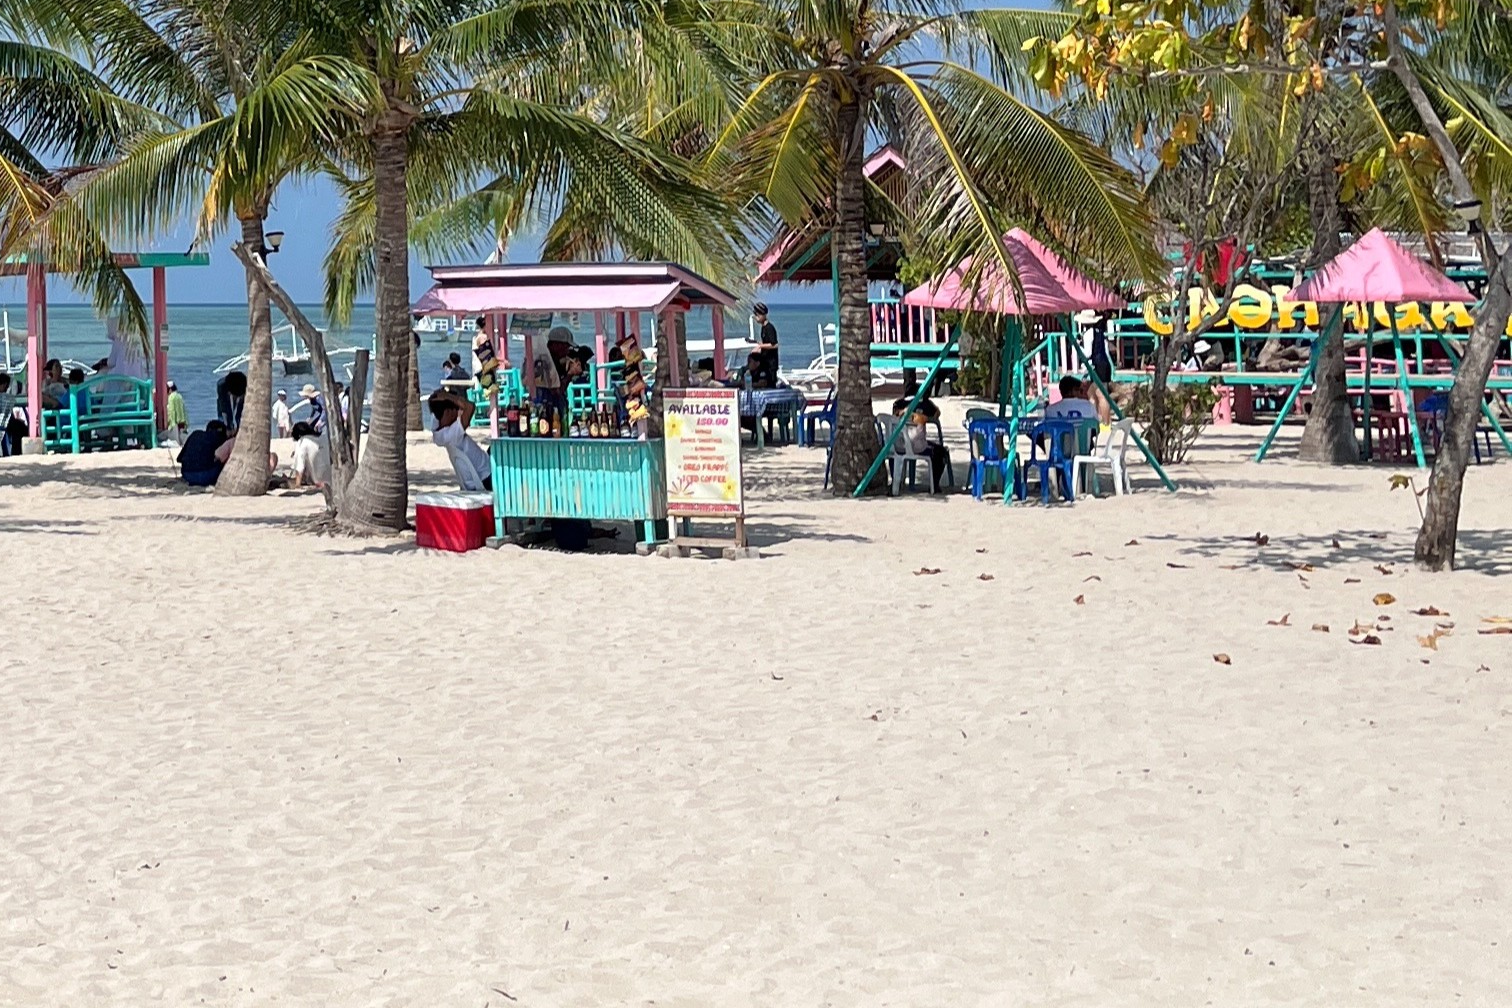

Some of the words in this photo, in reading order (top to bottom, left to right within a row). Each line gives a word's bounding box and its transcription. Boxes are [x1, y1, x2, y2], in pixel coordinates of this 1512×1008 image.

[668, 403, 730, 415] AVAILABLE
[696, 417, 729, 426] 150.00
[700, 475, 727, 484] COFFEE
